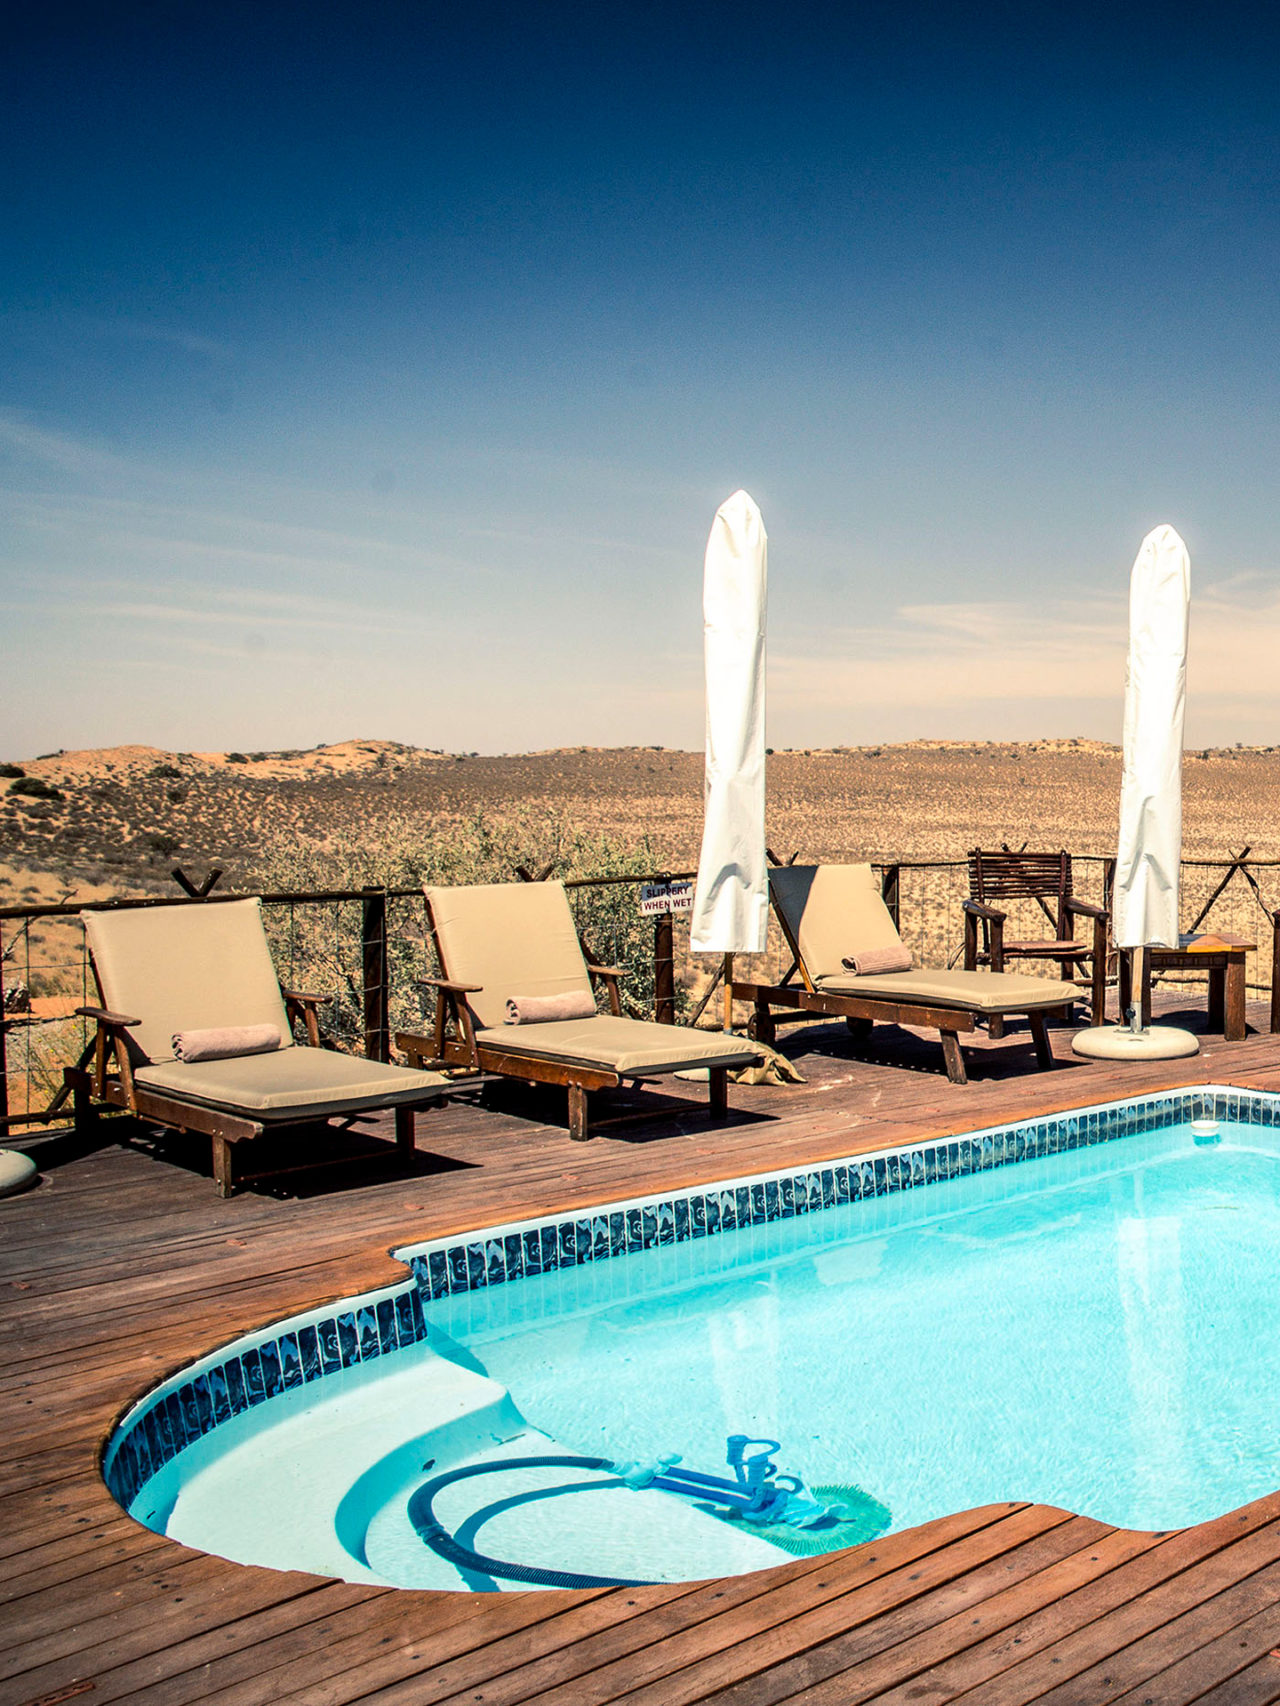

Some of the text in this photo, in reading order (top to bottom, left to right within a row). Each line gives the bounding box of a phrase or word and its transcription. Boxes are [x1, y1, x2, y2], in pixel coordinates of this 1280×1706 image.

[646, 886, 689, 898] SLIPPERY
[644, 898, 692, 910] WHEN WET
